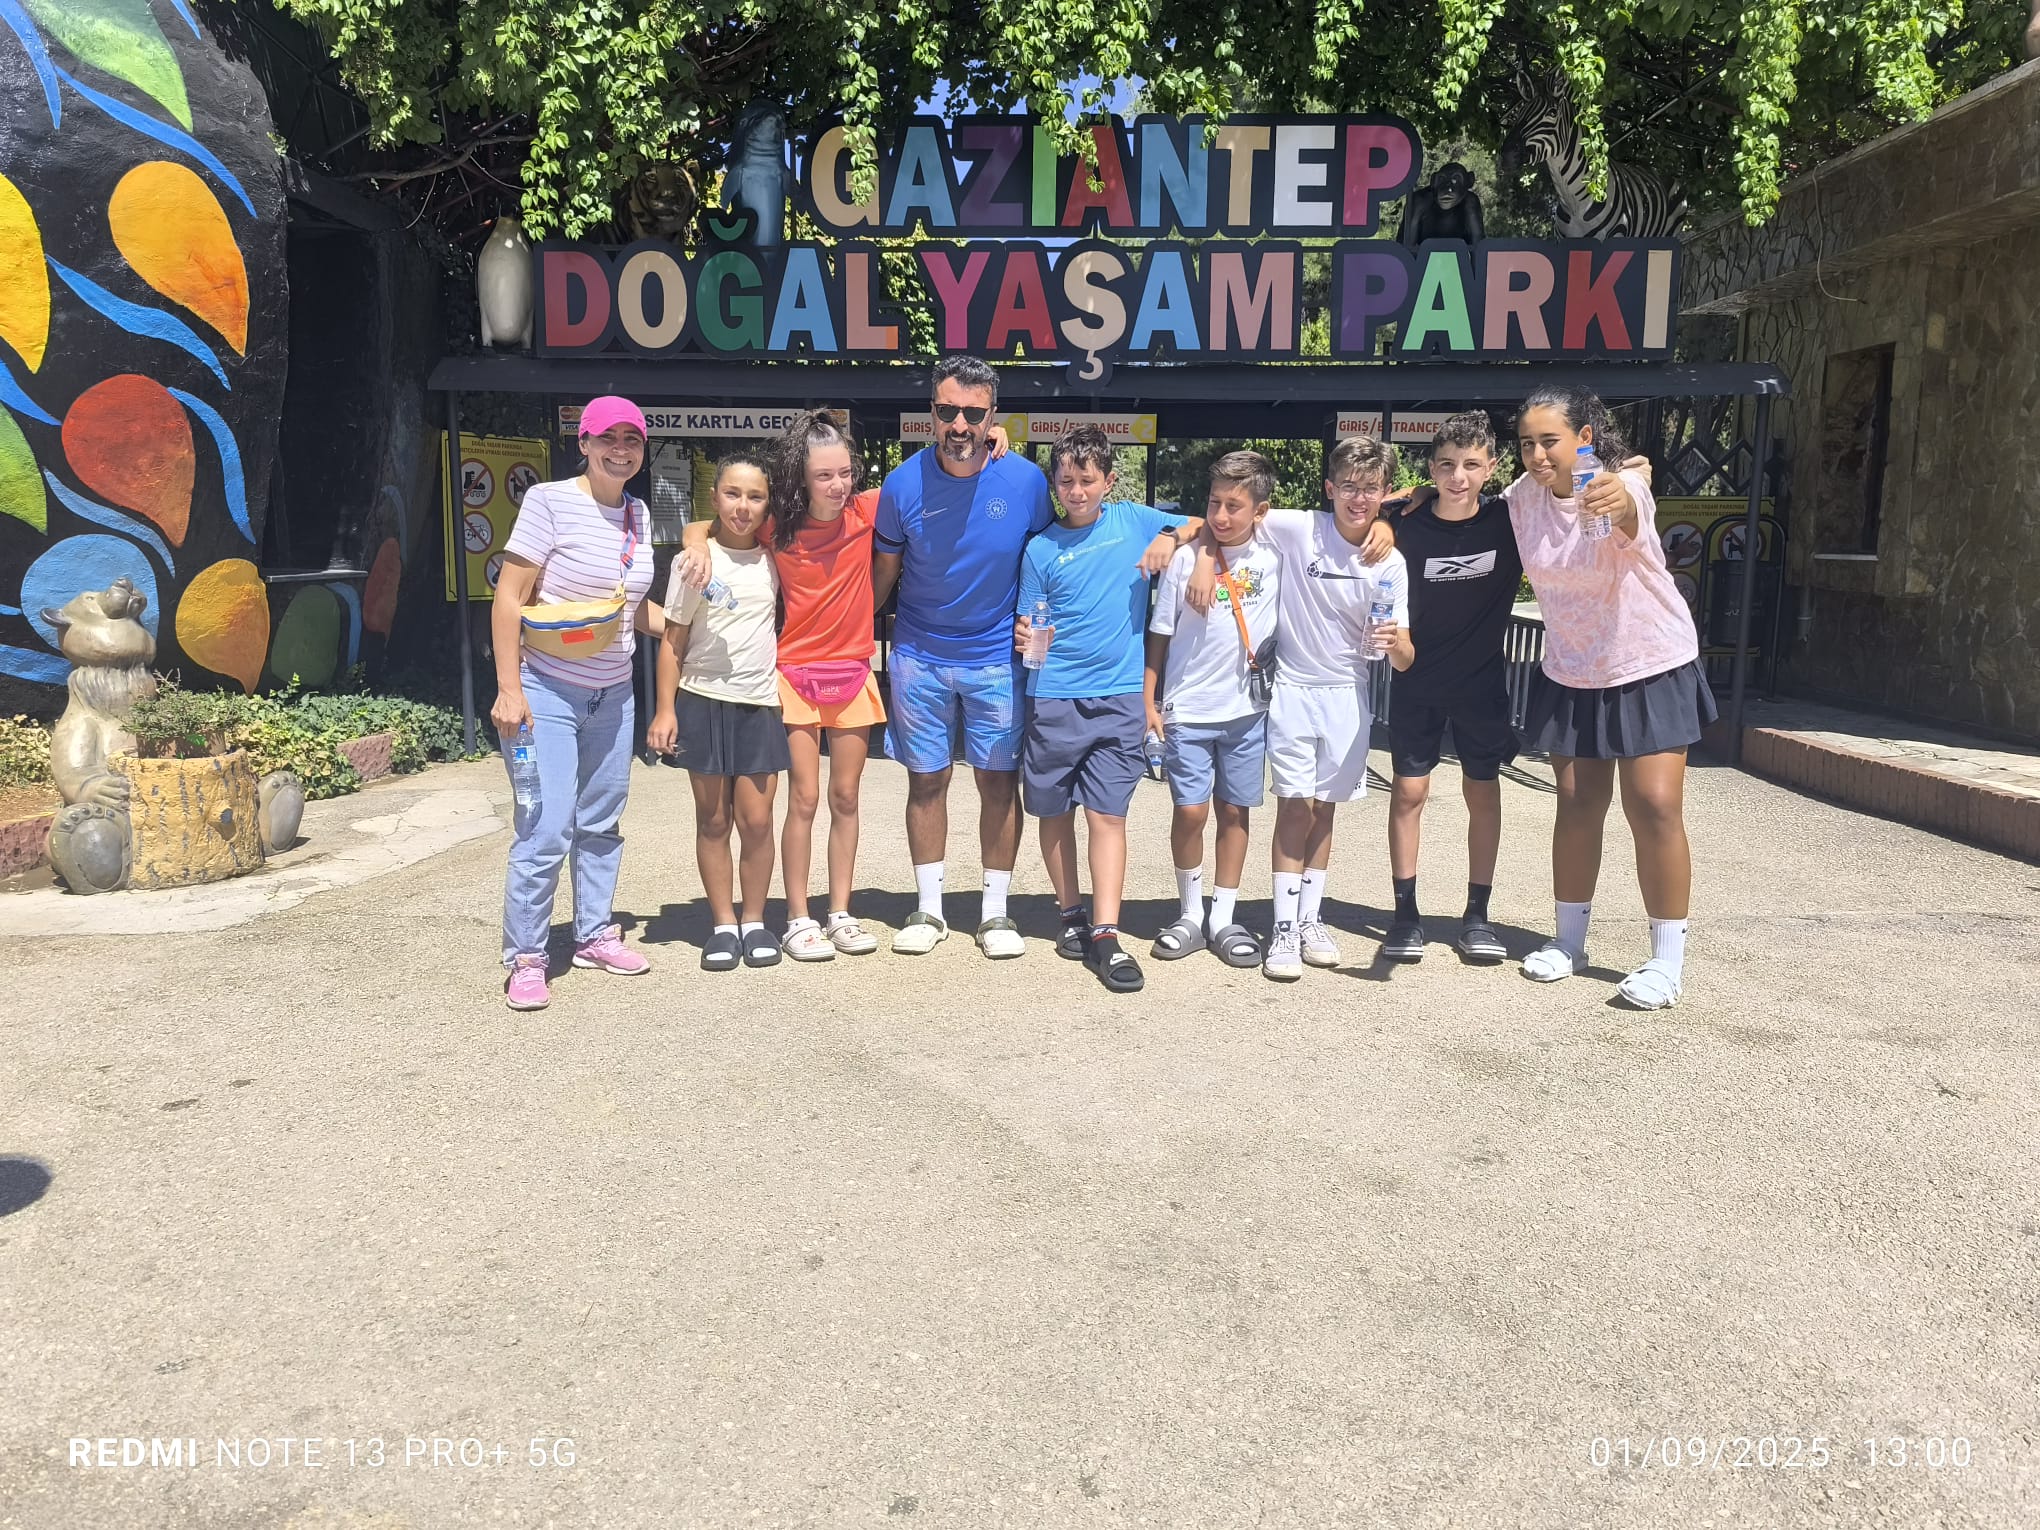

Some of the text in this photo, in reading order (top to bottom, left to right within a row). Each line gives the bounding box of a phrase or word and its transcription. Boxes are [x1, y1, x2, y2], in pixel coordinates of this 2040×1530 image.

[543, 218, 1673, 381] DOĞAL YAŞAM PARKI
[645, 414, 682, 429] SSIZ
[687, 414, 754, 429] KARTLA
[1012, 418, 1024, 438] 3
[1141, 419, 1153, 439] 2
